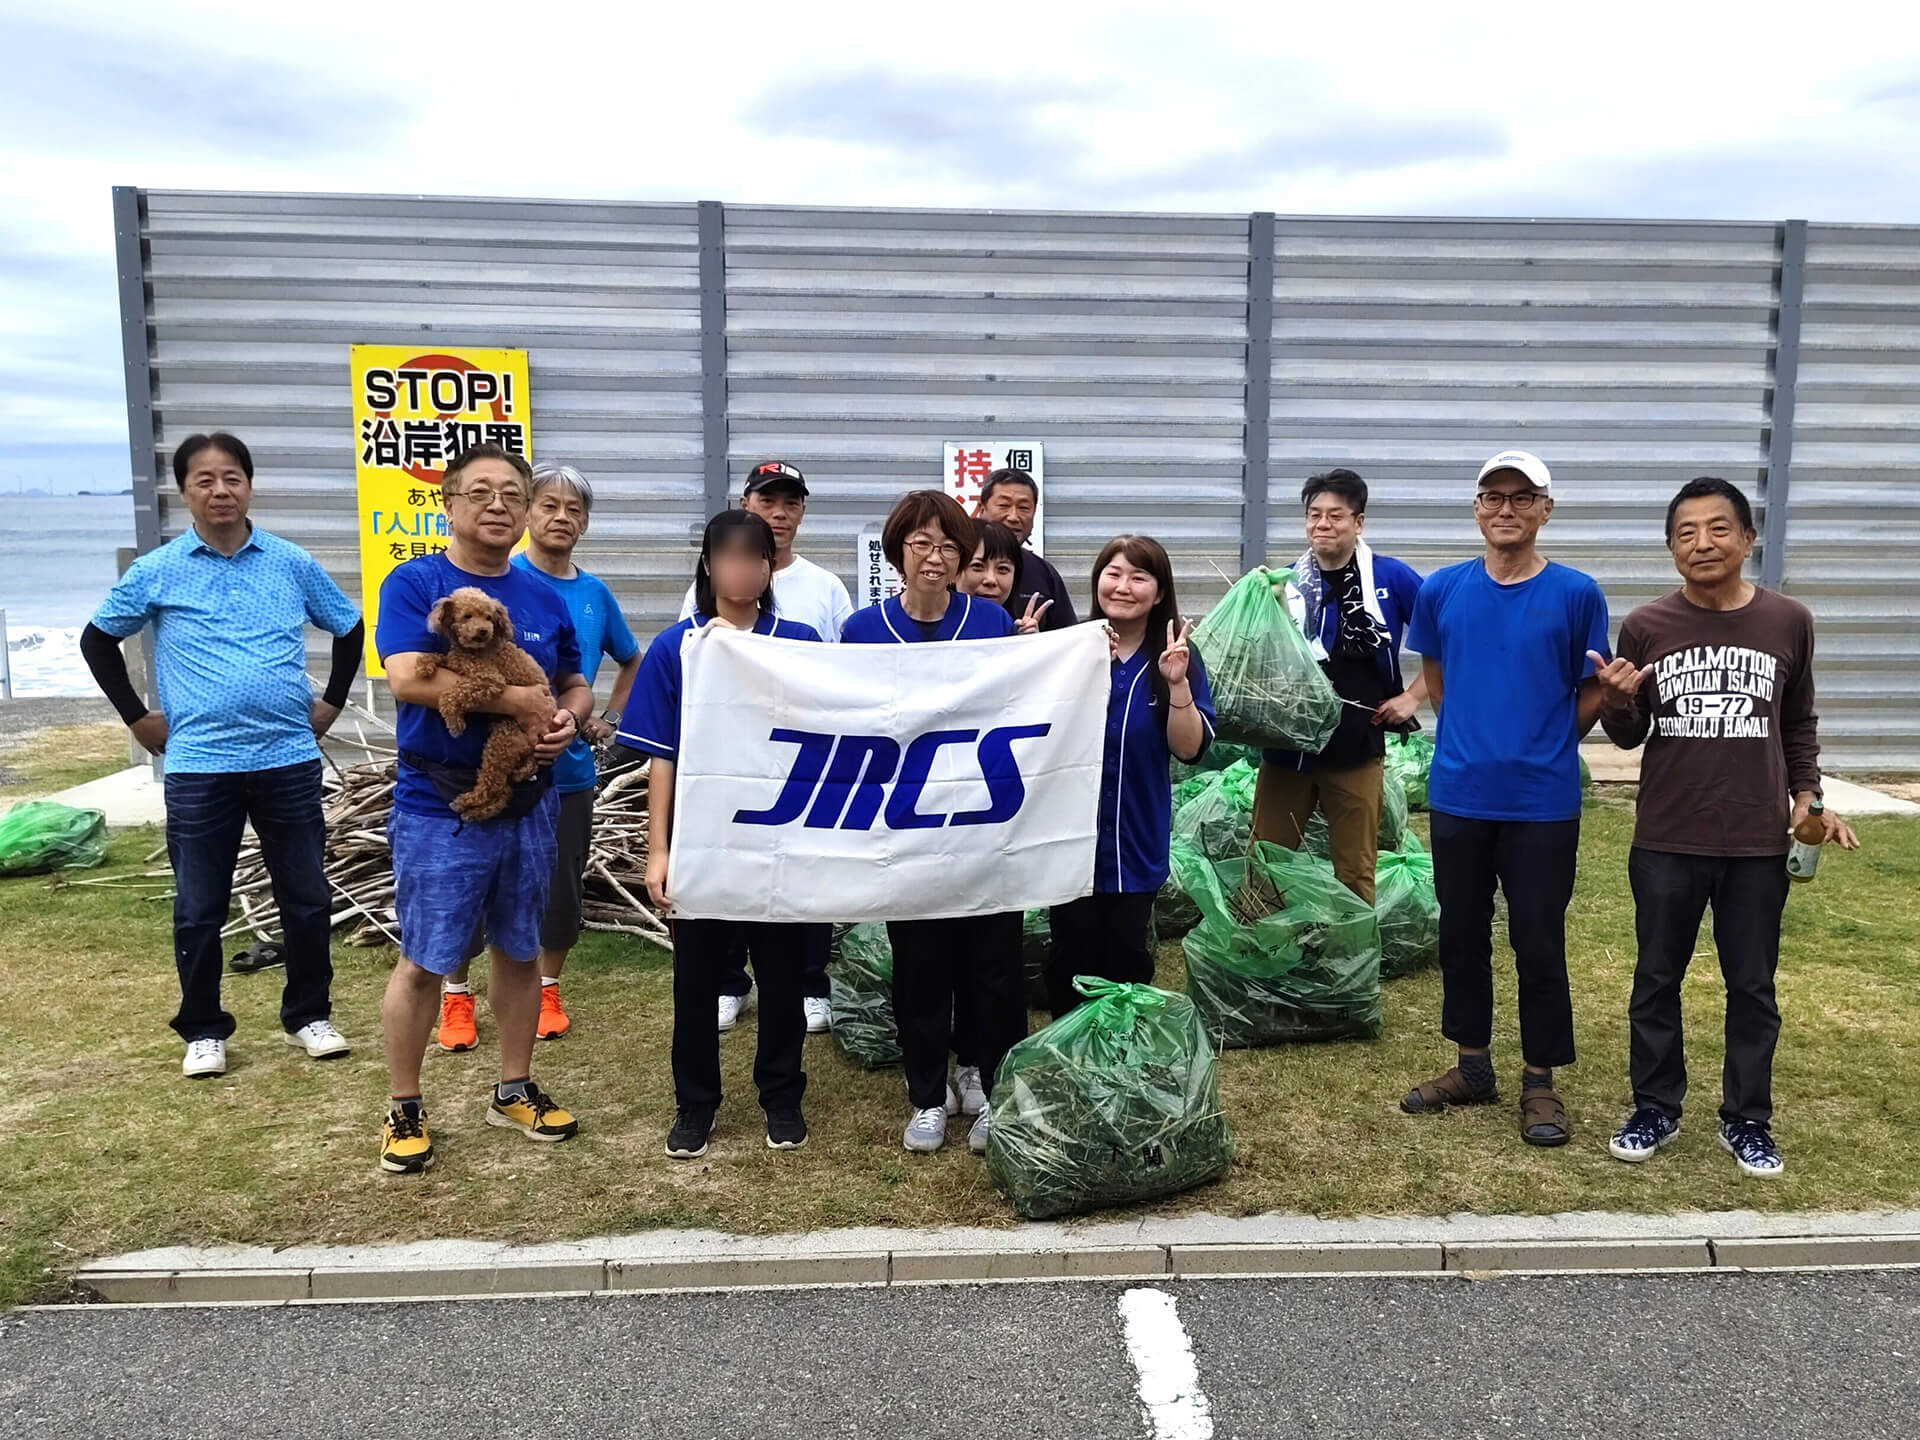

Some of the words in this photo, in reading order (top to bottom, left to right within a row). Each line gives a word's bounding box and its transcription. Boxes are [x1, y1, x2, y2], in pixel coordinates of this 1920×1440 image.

[366, 370, 512, 413] STOP!
[1658, 670, 1722, 704] HAWAIIAN
[1727, 671, 1774, 702] ISLAND
[1658, 717, 1720, 738] HONOLULU
[1723, 717, 1769, 738] HAWAII
[732, 722, 1052, 831] JRCS
